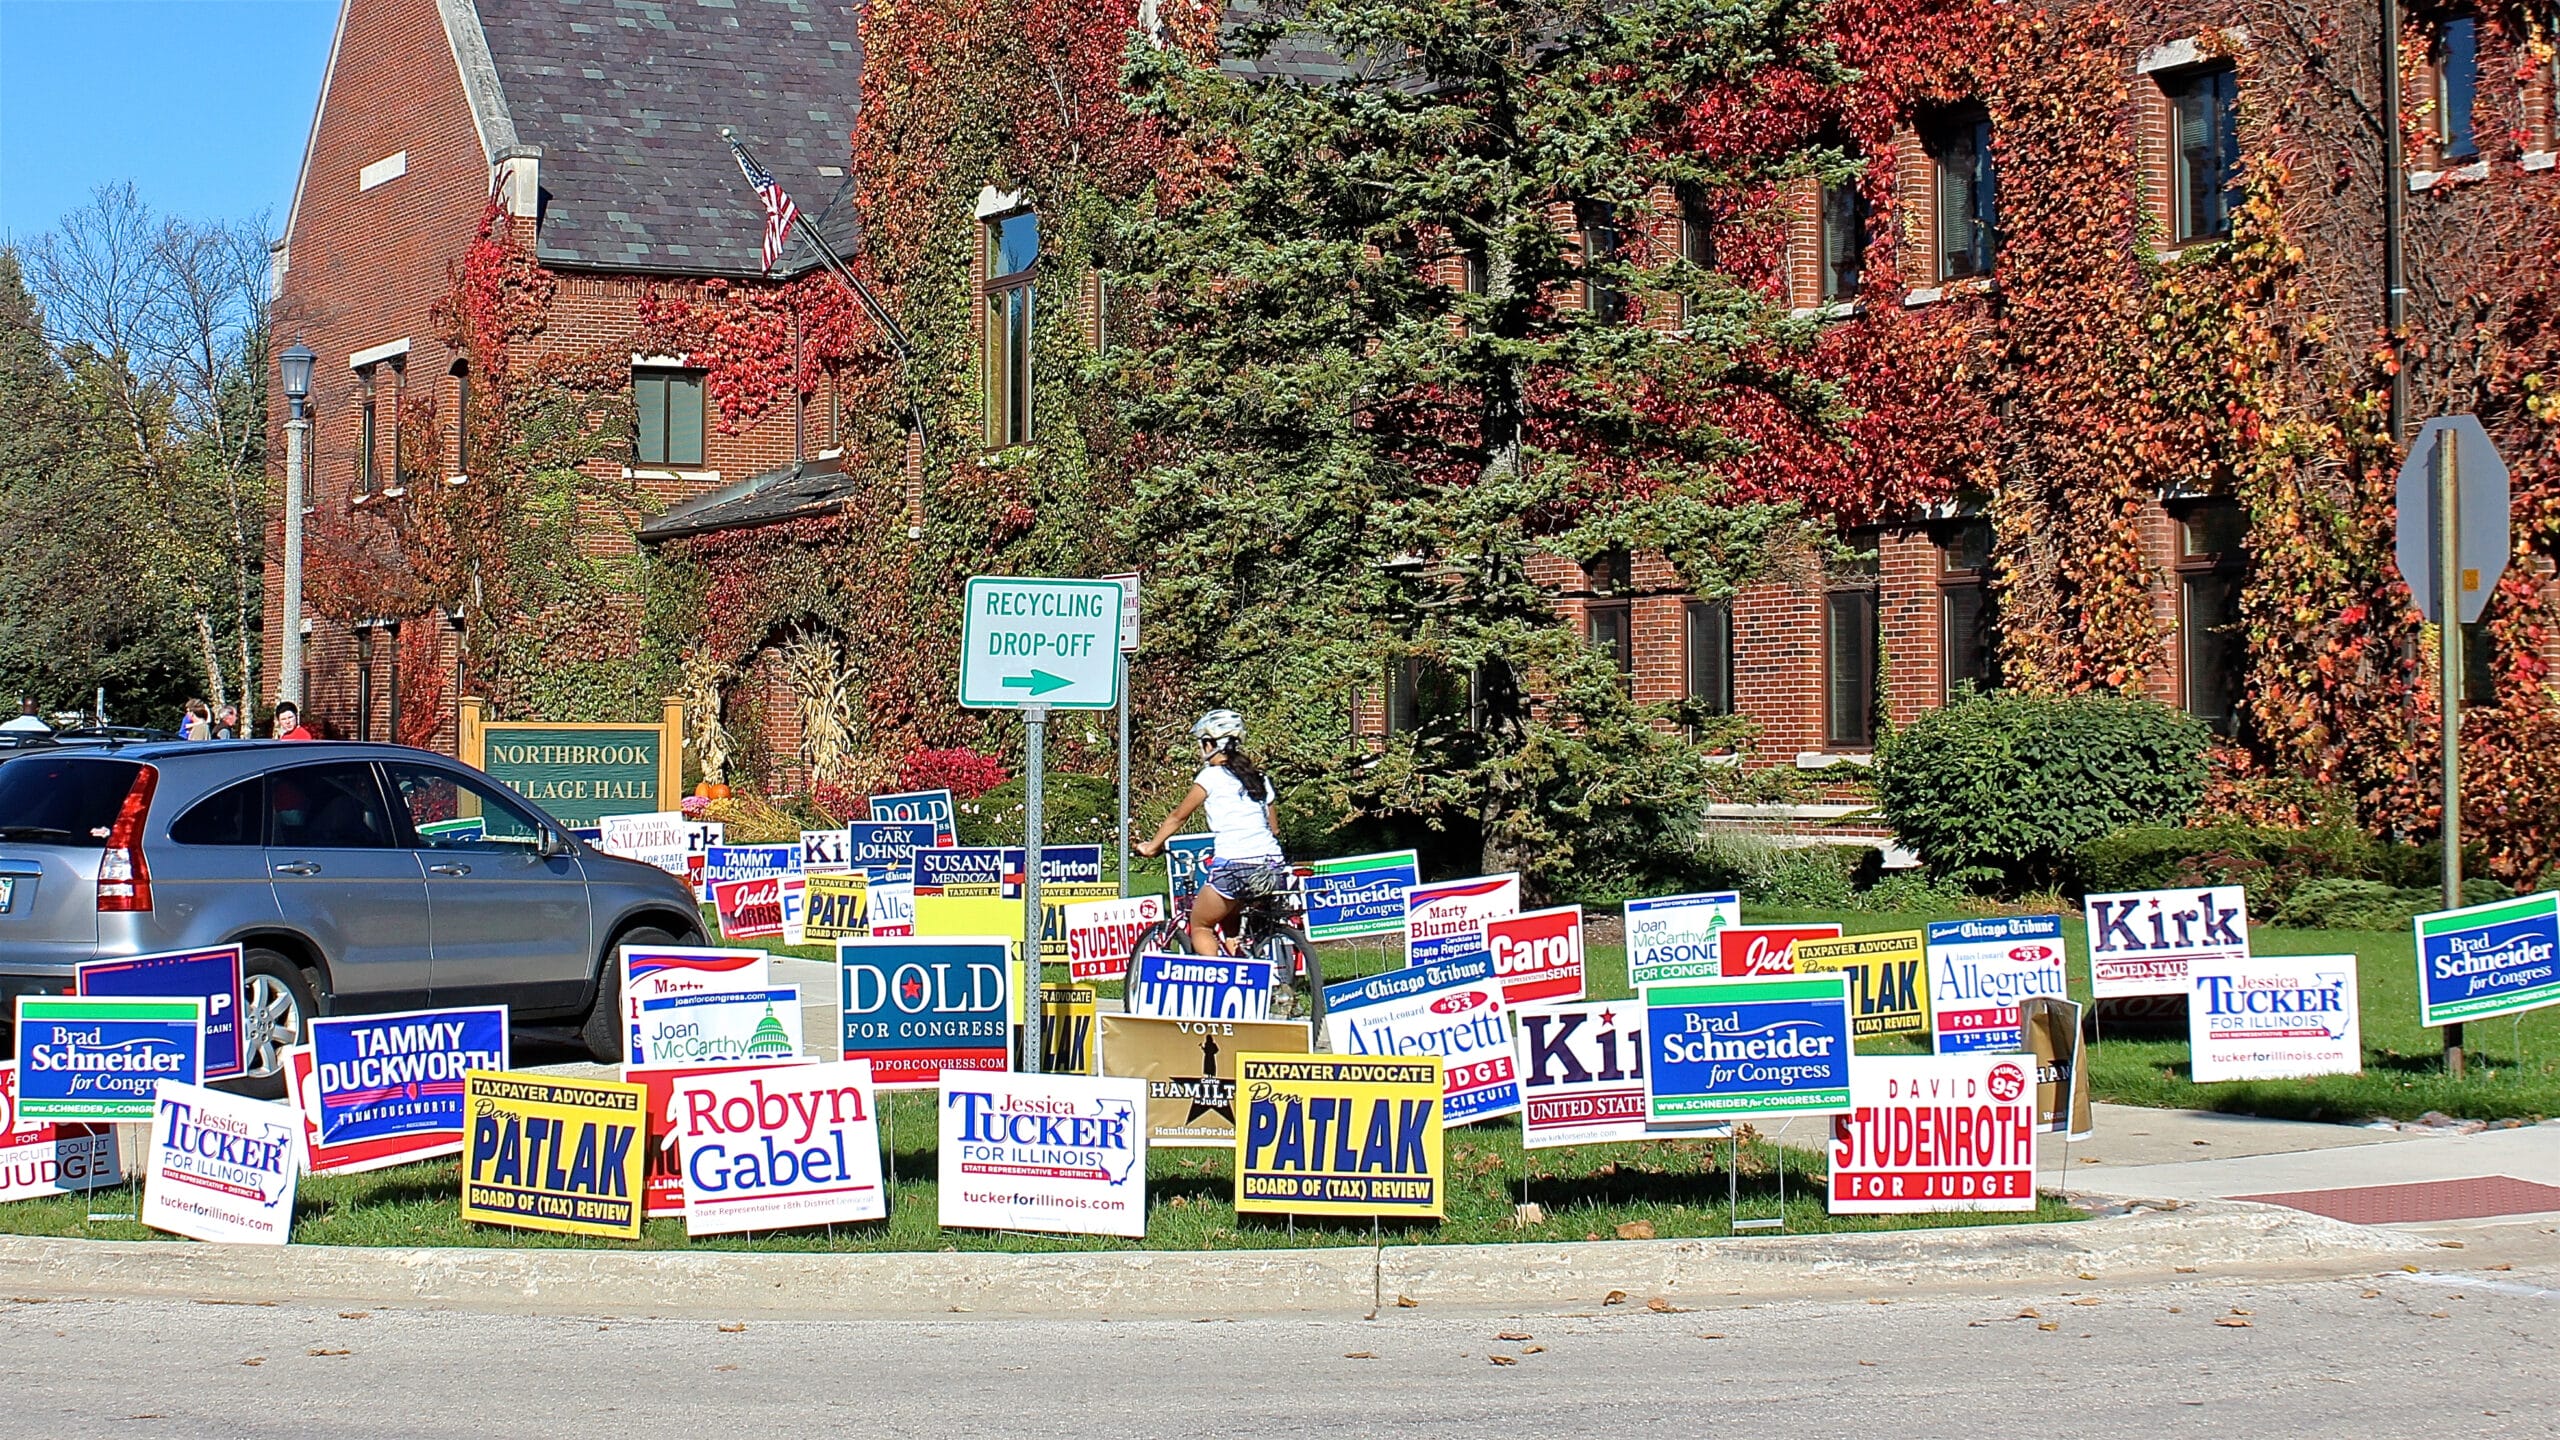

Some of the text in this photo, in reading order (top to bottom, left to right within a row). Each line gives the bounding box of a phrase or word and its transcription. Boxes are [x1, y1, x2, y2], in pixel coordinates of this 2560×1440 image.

[986, 592, 1103, 618] RECYCLING
[989, 632, 1096, 657] DROP-OFF
[493, 745, 650, 765] NORTHBROOK
[500, 780, 654, 799] ILLAGE HALL
[873, 801, 947, 822] DOLD
[610, 829, 681, 849] SALZBERG
[872, 830, 913, 843] GARY
[660, 854, 683, 862] STATE
[723, 852, 773, 867] TAMMY
[855, 842, 920, 862] JOHNSO
[708, 866, 786, 880] DUCKWORTH
[924, 855, 1000, 871] SUSANA
[1041, 861, 1098, 877] Clinton
[810, 878, 851, 888] TAXPAYER
[931, 873, 996, 884] MENDOZA
[1325, 876, 1356, 890] Brad
[949, 888, 989, 896] TAXPAYER
[1073, 887, 1118, 896] ADVOCATE
[1314, 886, 1404, 909] Schneide
[722, 904, 782, 928] MORRIS
[1094, 908, 1136, 923] DAVID
[1142, 905, 1156, 917] 95
[1339, 903, 1404, 921] for Congres
[1429, 905, 1467, 919] Marty
[806, 928, 831, 937] BOARD
[1633, 920, 1667, 934] Joan
[1961, 919, 2054, 938] Chicago Tribune
[2091, 892, 2244, 953] Kirk
[1634, 930, 1704, 948] McCarthy
[1800, 938, 1916, 958] TAXPAYER ADVOCATE
[2449, 932, 2490, 954] Brad
[1055, 945, 1066, 954] OF
[1412, 946, 1439, 958] State
[1491, 925, 1579, 975] Carol
[2435, 940, 2554, 979] Schneider
[1081, 960, 1108, 974] FOR
[1157, 960, 1254, 985] James E.
[1546, 965, 1581, 981] SENTE
[1634, 963, 1718, 982] FOR CONGRE
[2097, 960, 2189, 978] UNITED STATE
[844, 963, 1004, 1014] DOLD
[1329, 988, 1363, 1008] Endorsed
[1365, 978, 1425, 1000] Chicago
[1427, 960, 1487, 986] Tribune
[1937, 953, 2063, 1007] Allegretti
[2238, 973, 2299, 990] Jessica
[2465, 965, 2552, 996] for Congress
[675, 992, 766, 1007] joanforcongress.com
[1050, 991, 1091, 1003] ADVOCATE
[2197, 975, 2344, 1016] TUCKER
[1362, 1007, 1425, 1027] James Leonard
[1684, 1011, 1740, 1033] Brad
[1856, 1014, 1921, 1033] (TAX) REVIEW
[1953, 1015, 1983, 1027] FOR
[2211, 1015, 2319, 1029] FOR ILLINOIS
[52, 1027, 101, 1045] Brad
[652, 1022, 699, 1040] Joan
[847, 1021, 1005, 1039] FOR CONGRESS
[1176, 1022, 1234, 1036] VOTE
[1350, 1002, 1508, 1056] Allegretti
[2211, 1031, 2230, 1039] STATE
[351, 1022, 465, 1058] TAMMY
[653, 1036, 750, 1060] McCarthy
[1522, 1008, 1643, 1088] Ki
[1663, 1028, 1835, 1063] Schneider
[31, 1043, 186, 1072] Schneider
[2212, 1051, 2344, 1063] tuckerforillinois.com
[320, 1050, 500, 1094] DUCKWORTH
[1246, 1064, 1432, 1082] TAXPAYER ADVOCATE
[1705, 1063, 1831, 1089] for Congress
[1993, 1066, 2024, 1082] PUNCH
[66, 1074, 160, 1096] for Congr
[473, 1080, 636, 1110] TAXPAYER ADVOCATE
[1150, 1081, 1235, 1099] HAMILT
[1249, 1082, 1303, 1104] Dan
[1889, 1079, 1976, 1099] DAVID
[1991, 1078, 2020, 1099] 95
[475, 1098, 521, 1123] Dan
[684, 1080, 868, 1144] Robyn
[999, 1094, 1075, 1115] Jessica
[1530, 1096, 1645, 1120] UNITED STATE
[195, 1108, 249, 1135] Jessica
[948, 1091, 1129, 1150] TUCKER
[15, 1134, 39, 1144] FOR
[160, 1099, 283, 1175] TUCKER
[1245, 1097, 1434, 1174] PATLAK
[1835, 1105, 2032, 1169] STUDENROTH
[57, 1138, 109, 1156] COURT
[471, 1116, 637, 1198] PATLAK
[963, 1145, 1096, 1167] FOR ILLINOIS
[0, 1151, 110, 1190] JUDGE
[164, 1152, 258, 1187] FOR ILLINOIS
[689, 1129, 851, 1192] Gabel
[963, 1165, 1093, 1178] STATE REPRESENTATIVE DISTRICT
[1246, 1177, 1431, 1200] BOARD OF (TAX) REVIEW
[1852, 1175, 2015, 1197] FOR JUDGE
[472, 1188, 630, 1222] BOARD OF (TAX) REVIEW
[695, 1198, 836, 1219] State Representative 18th District
[963, 1191, 1125, 1210] tuckerforillinois.com
[160, 1195, 274, 1232] tuckerforillinois.com
